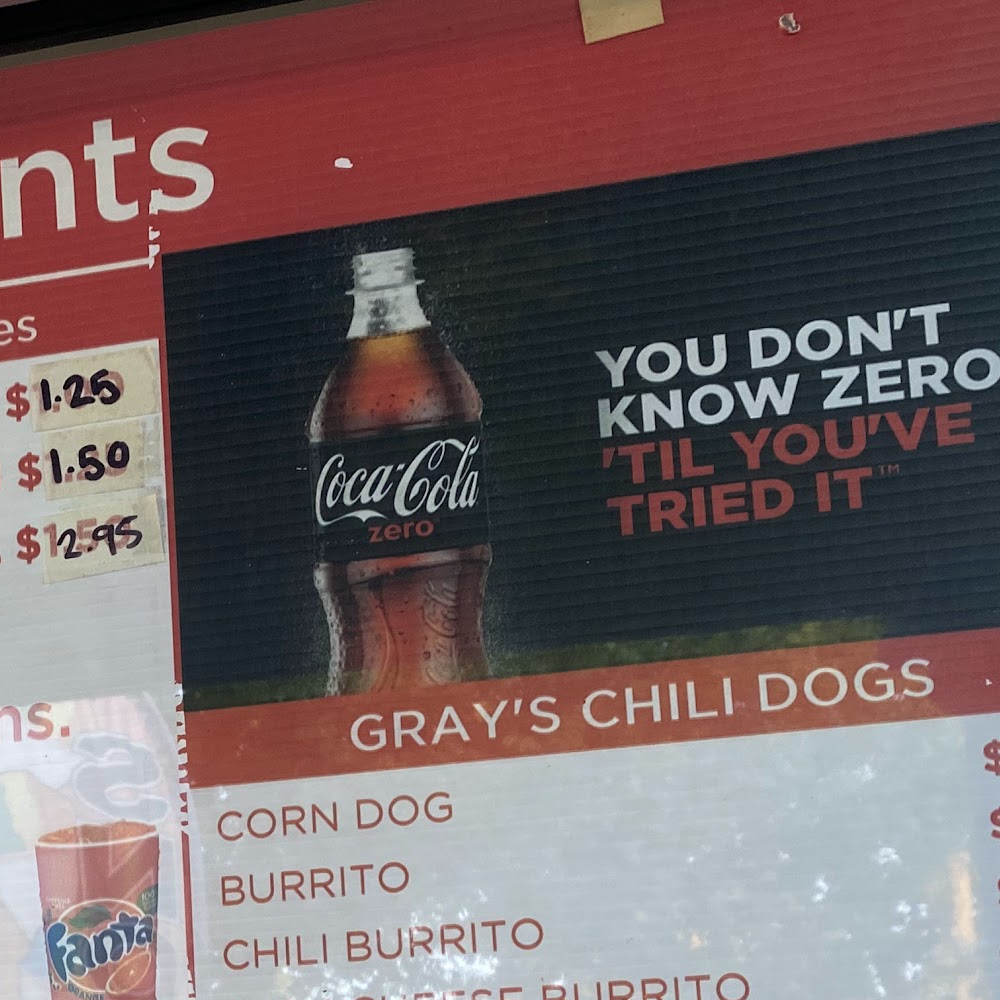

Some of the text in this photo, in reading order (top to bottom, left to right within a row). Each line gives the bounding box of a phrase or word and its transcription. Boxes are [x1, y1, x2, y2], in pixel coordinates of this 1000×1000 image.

[595, 302, 951, 388] YOU DON'T
[597, 348, 1000, 439] KNOW ZERO
[602, 402, 976, 485] 'TIL YOU'VE
[315, 436, 481, 526] Coca-Cola
[606, 478, 795, 537] TRIED
[368, 519, 435, 544] zero
[350, 658, 936, 752] GRAY'S CHILI DOGS
[216, 791, 454, 842] CORN DOG
[220, 861, 411, 907] BURRITO
[46, 911, 154, 983] Fanta
[222, 917, 545, 971] CHILI BURRITO
